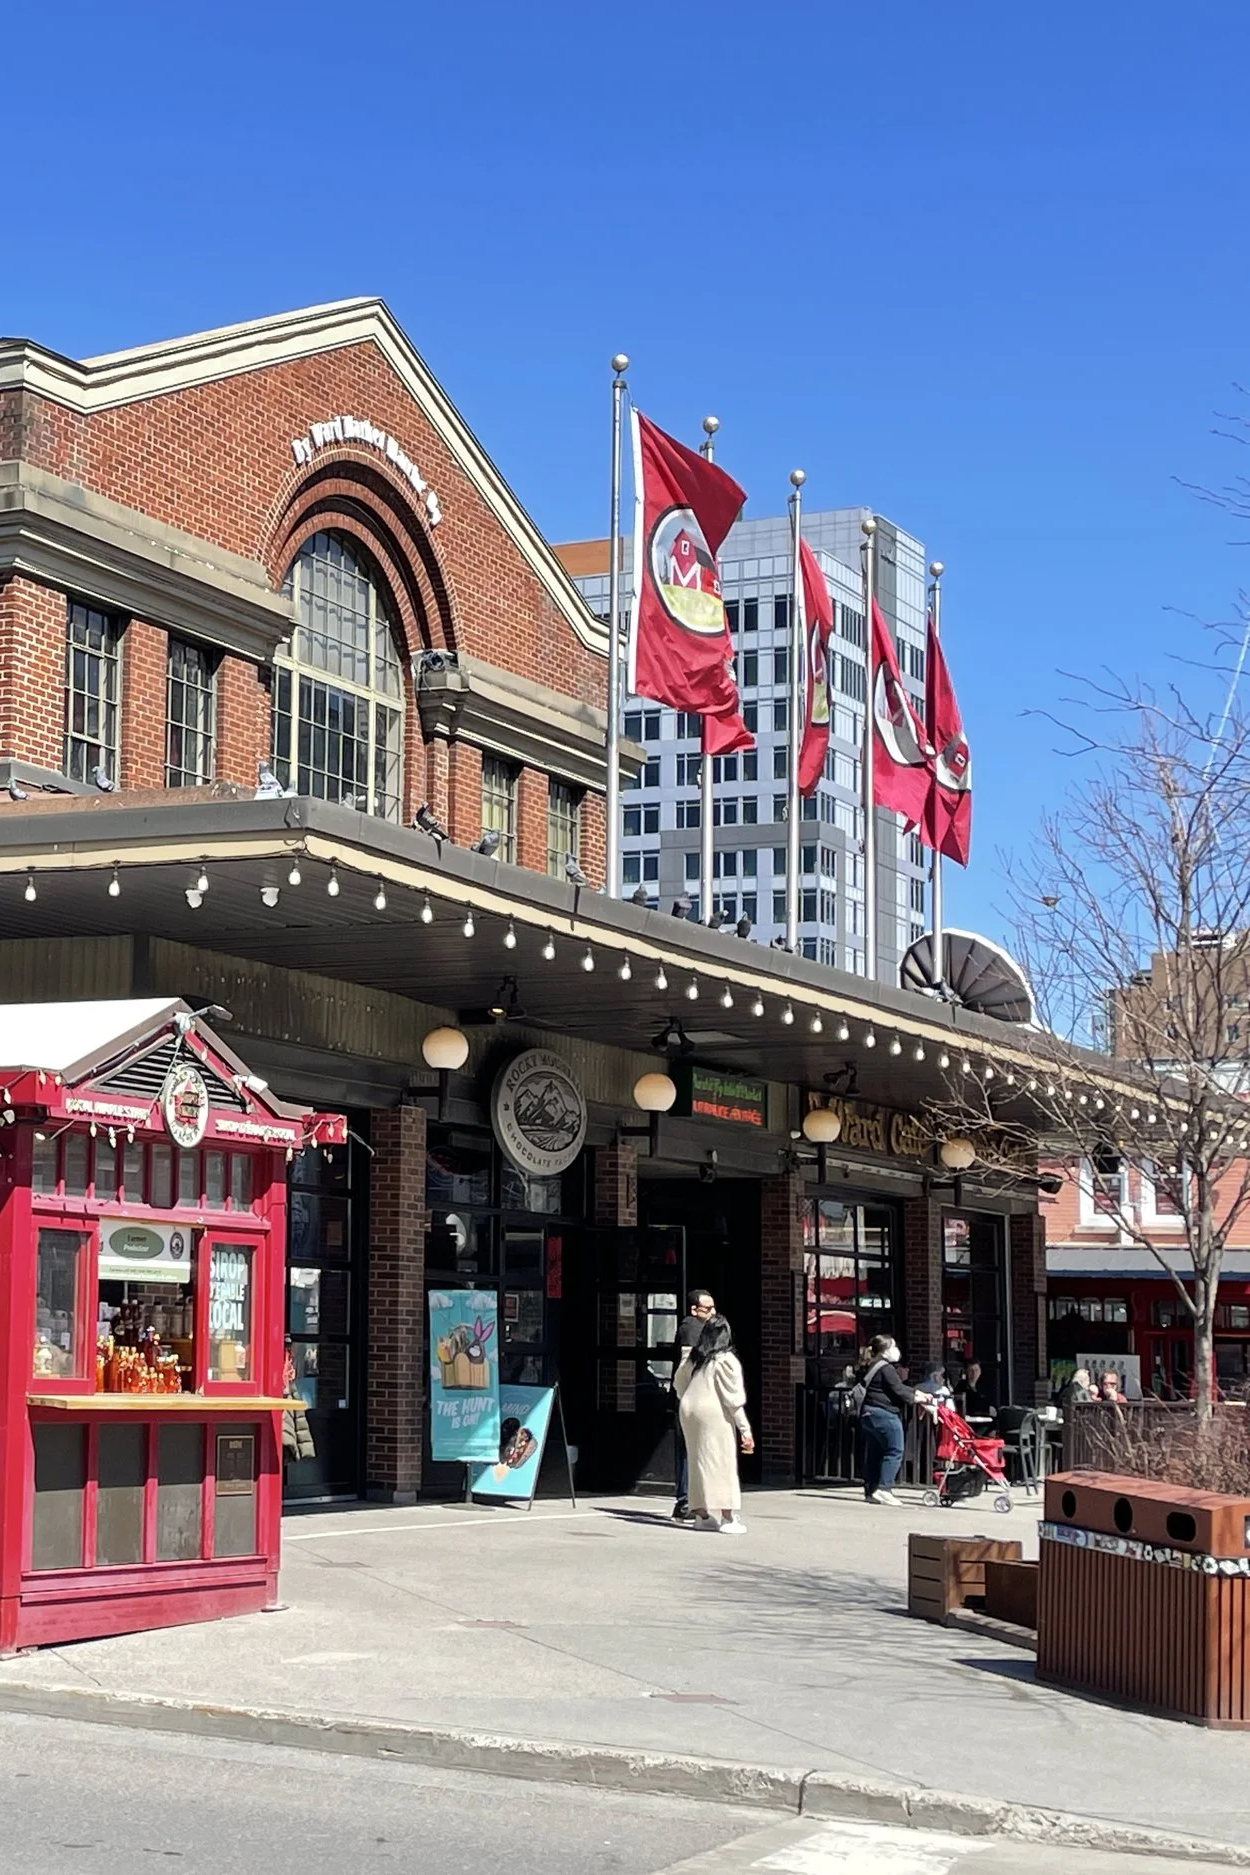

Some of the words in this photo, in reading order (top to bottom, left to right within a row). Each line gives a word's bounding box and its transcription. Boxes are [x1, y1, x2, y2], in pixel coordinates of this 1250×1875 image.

[506, 1054, 537, 1092] ROCKY
[506, 1122, 551, 1168] CHOCOLATE
[436, 1400, 459, 1416] THE
[461, 1397, 495, 1416] HUNT
[451, 1416, 461, 1429] IS
